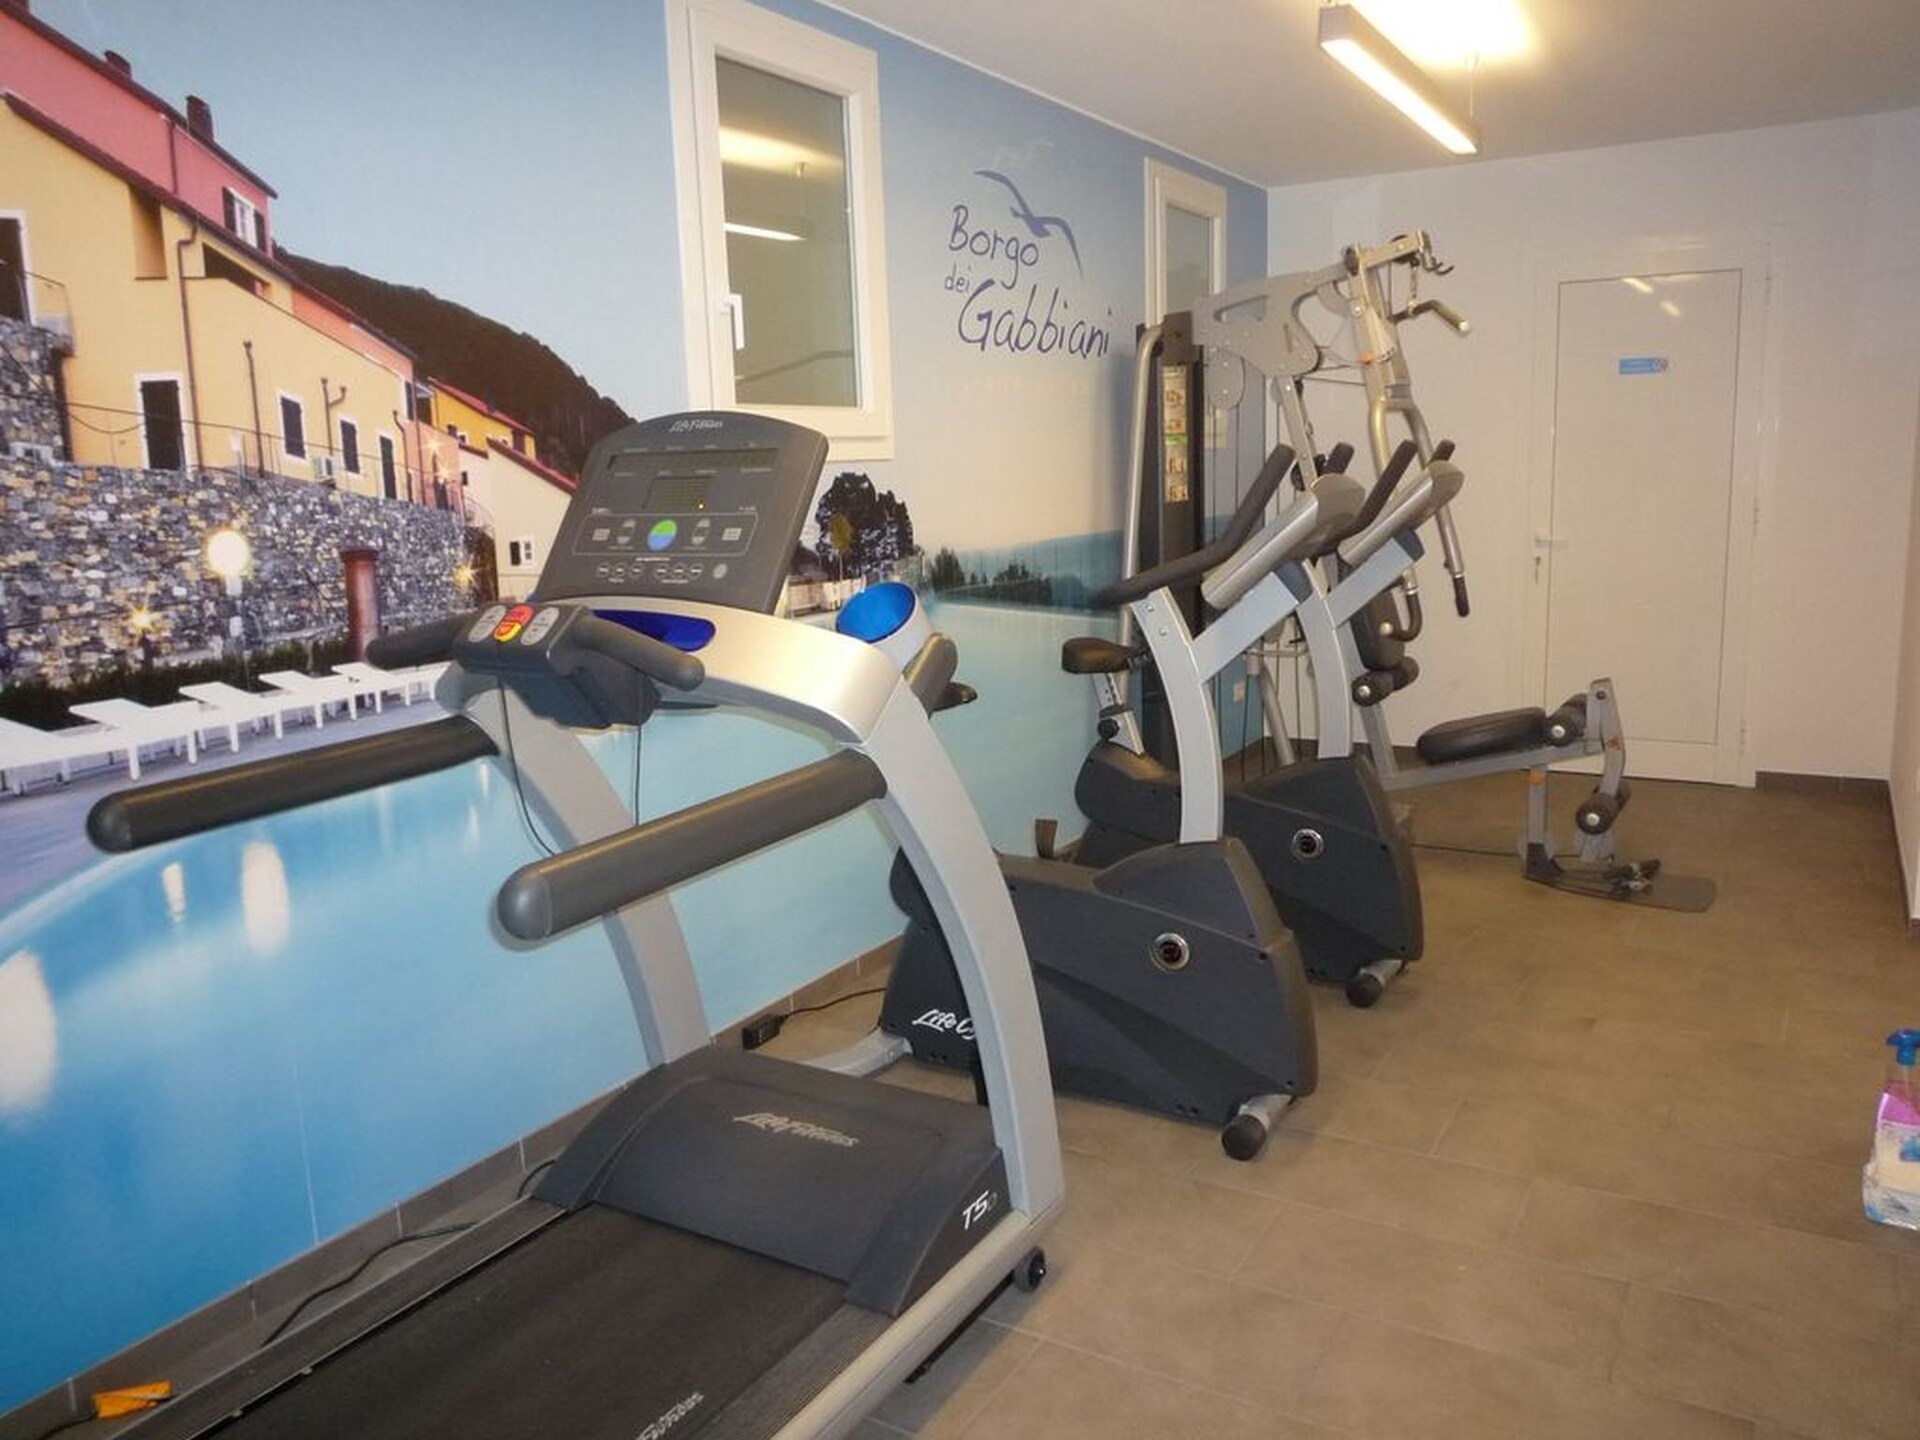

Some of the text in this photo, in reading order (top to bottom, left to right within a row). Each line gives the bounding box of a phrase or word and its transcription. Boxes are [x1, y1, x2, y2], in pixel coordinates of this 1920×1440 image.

[944, 262, 972, 294] dei
[948, 204, 1040, 290] Borgo
[957, 277, 1111, 360] Gabbiani
